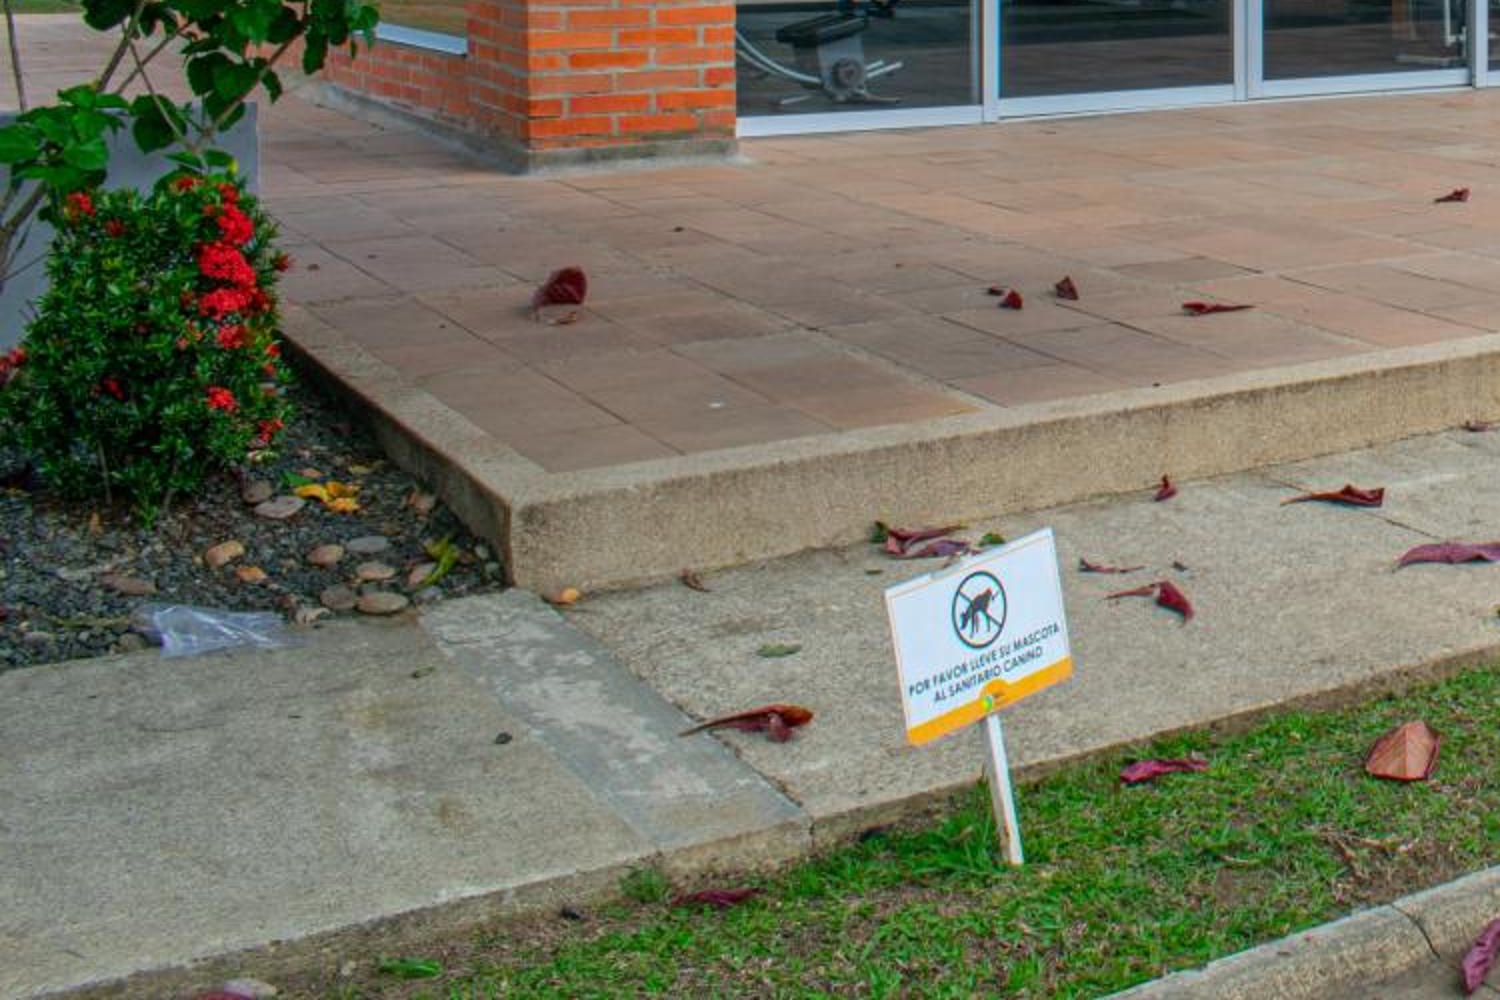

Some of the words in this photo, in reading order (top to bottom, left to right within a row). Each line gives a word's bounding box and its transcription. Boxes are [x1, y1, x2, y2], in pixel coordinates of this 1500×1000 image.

[909, 677, 930, 696] POR
[933, 662, 968, 685] FAVOR
[970, 649, 999, 671] LLEVE
[999, 645, 1011, 659] SU
[1013, 622, 1060, 649] MASCOTA
[934, 690, 947, 702] AL
[949, 664, 1001, 697] SANITARIO
[1003, 646, 1043, 673] CANINO
